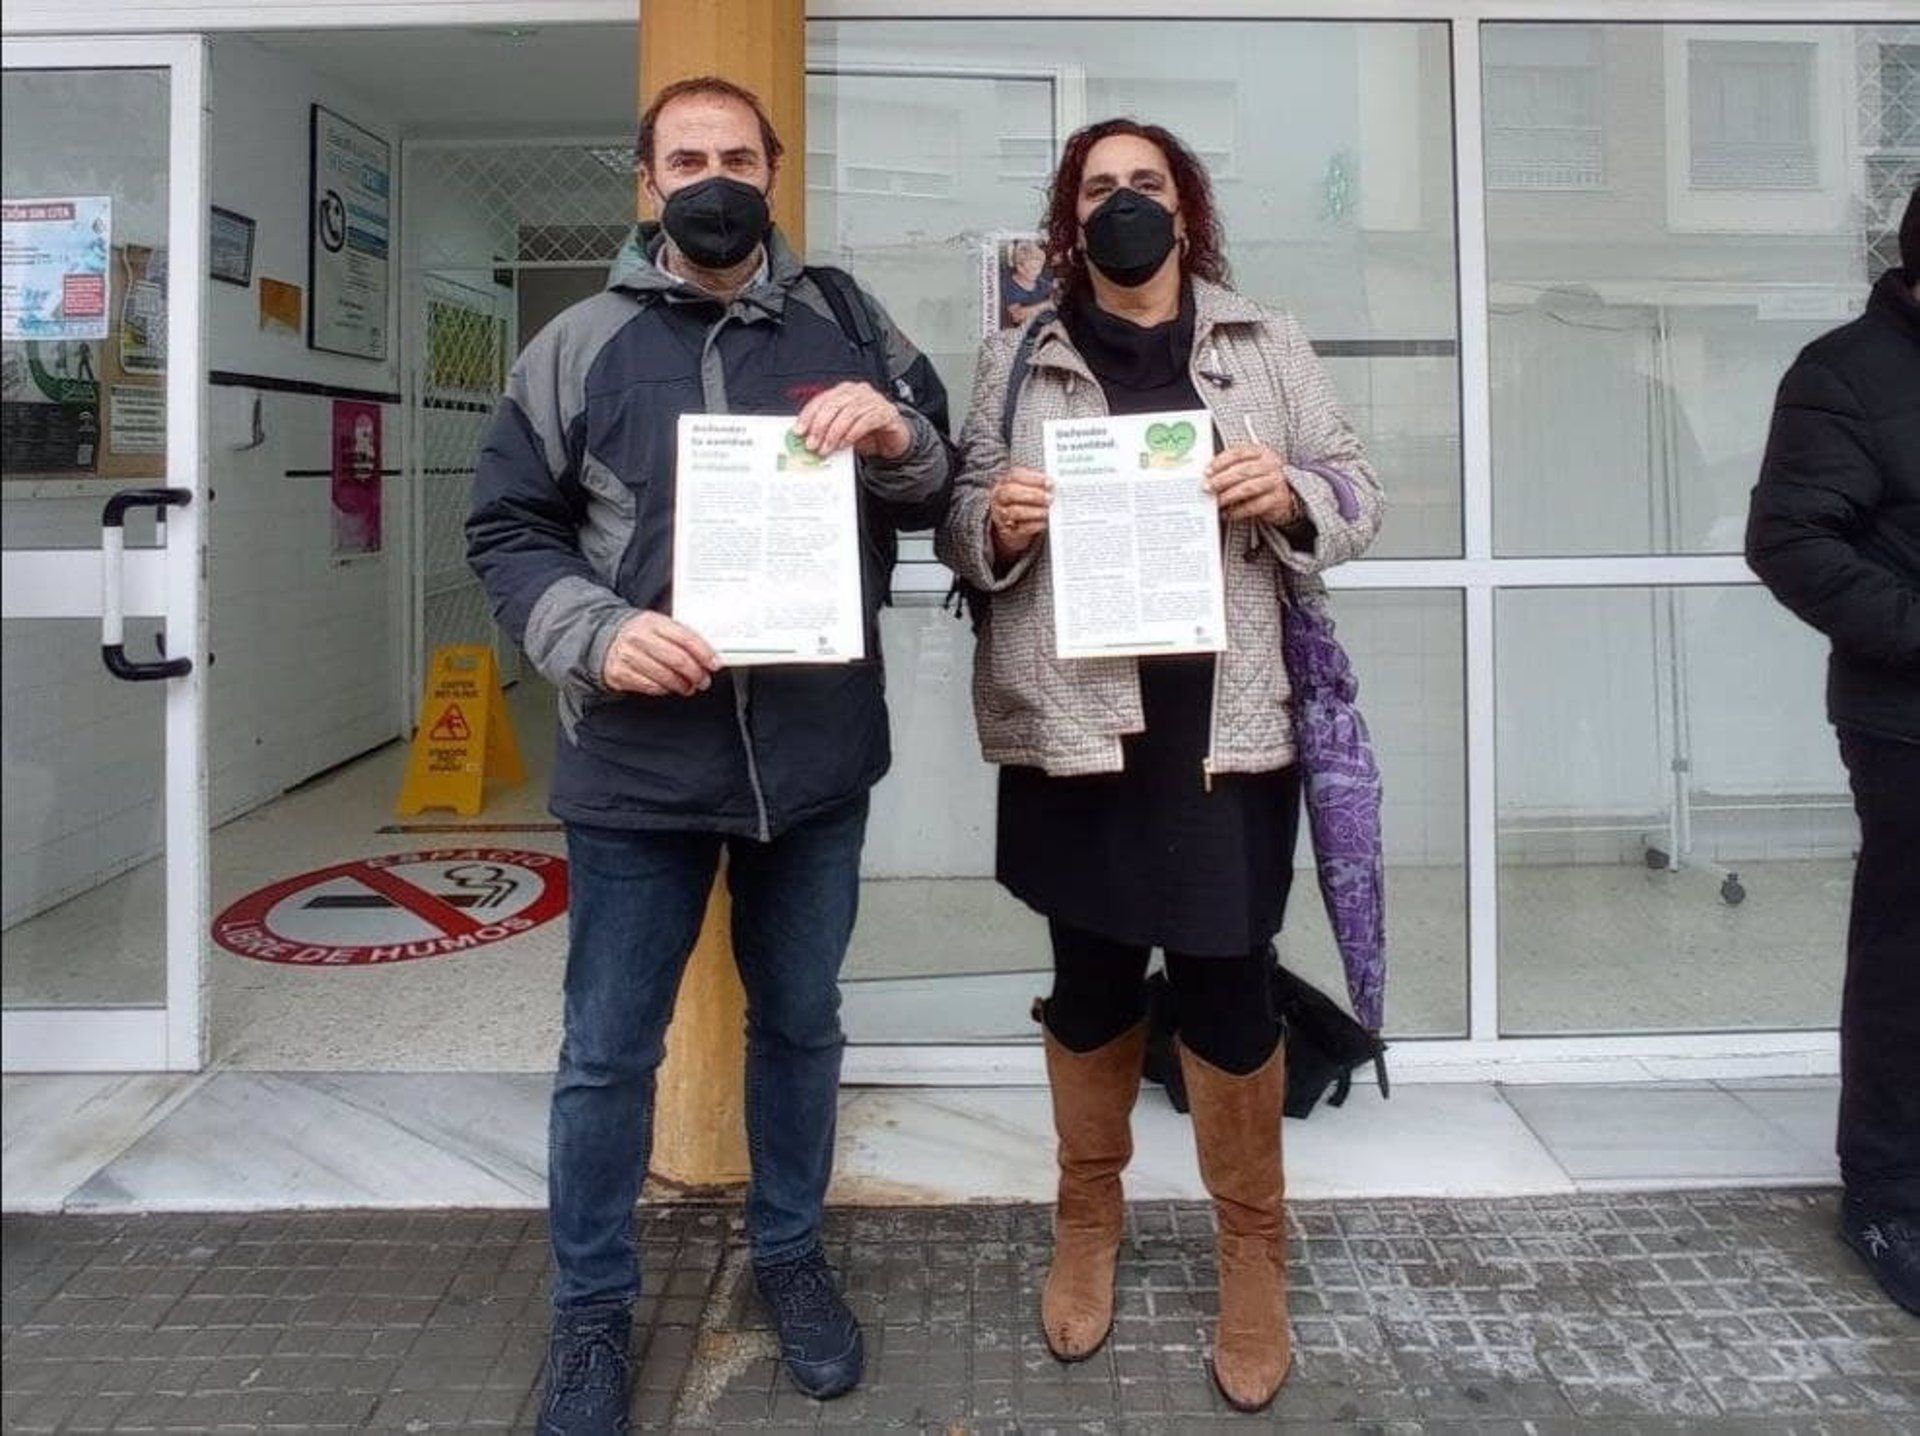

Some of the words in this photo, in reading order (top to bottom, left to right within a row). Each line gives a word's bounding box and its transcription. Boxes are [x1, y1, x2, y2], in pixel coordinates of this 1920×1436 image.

[366, 849, 552, 869] ESPACIO
[221, 920, 298, 958] LIBRE
[290, 947, 360, 964] DE
[368, 917, 535, 963] HUMOS
